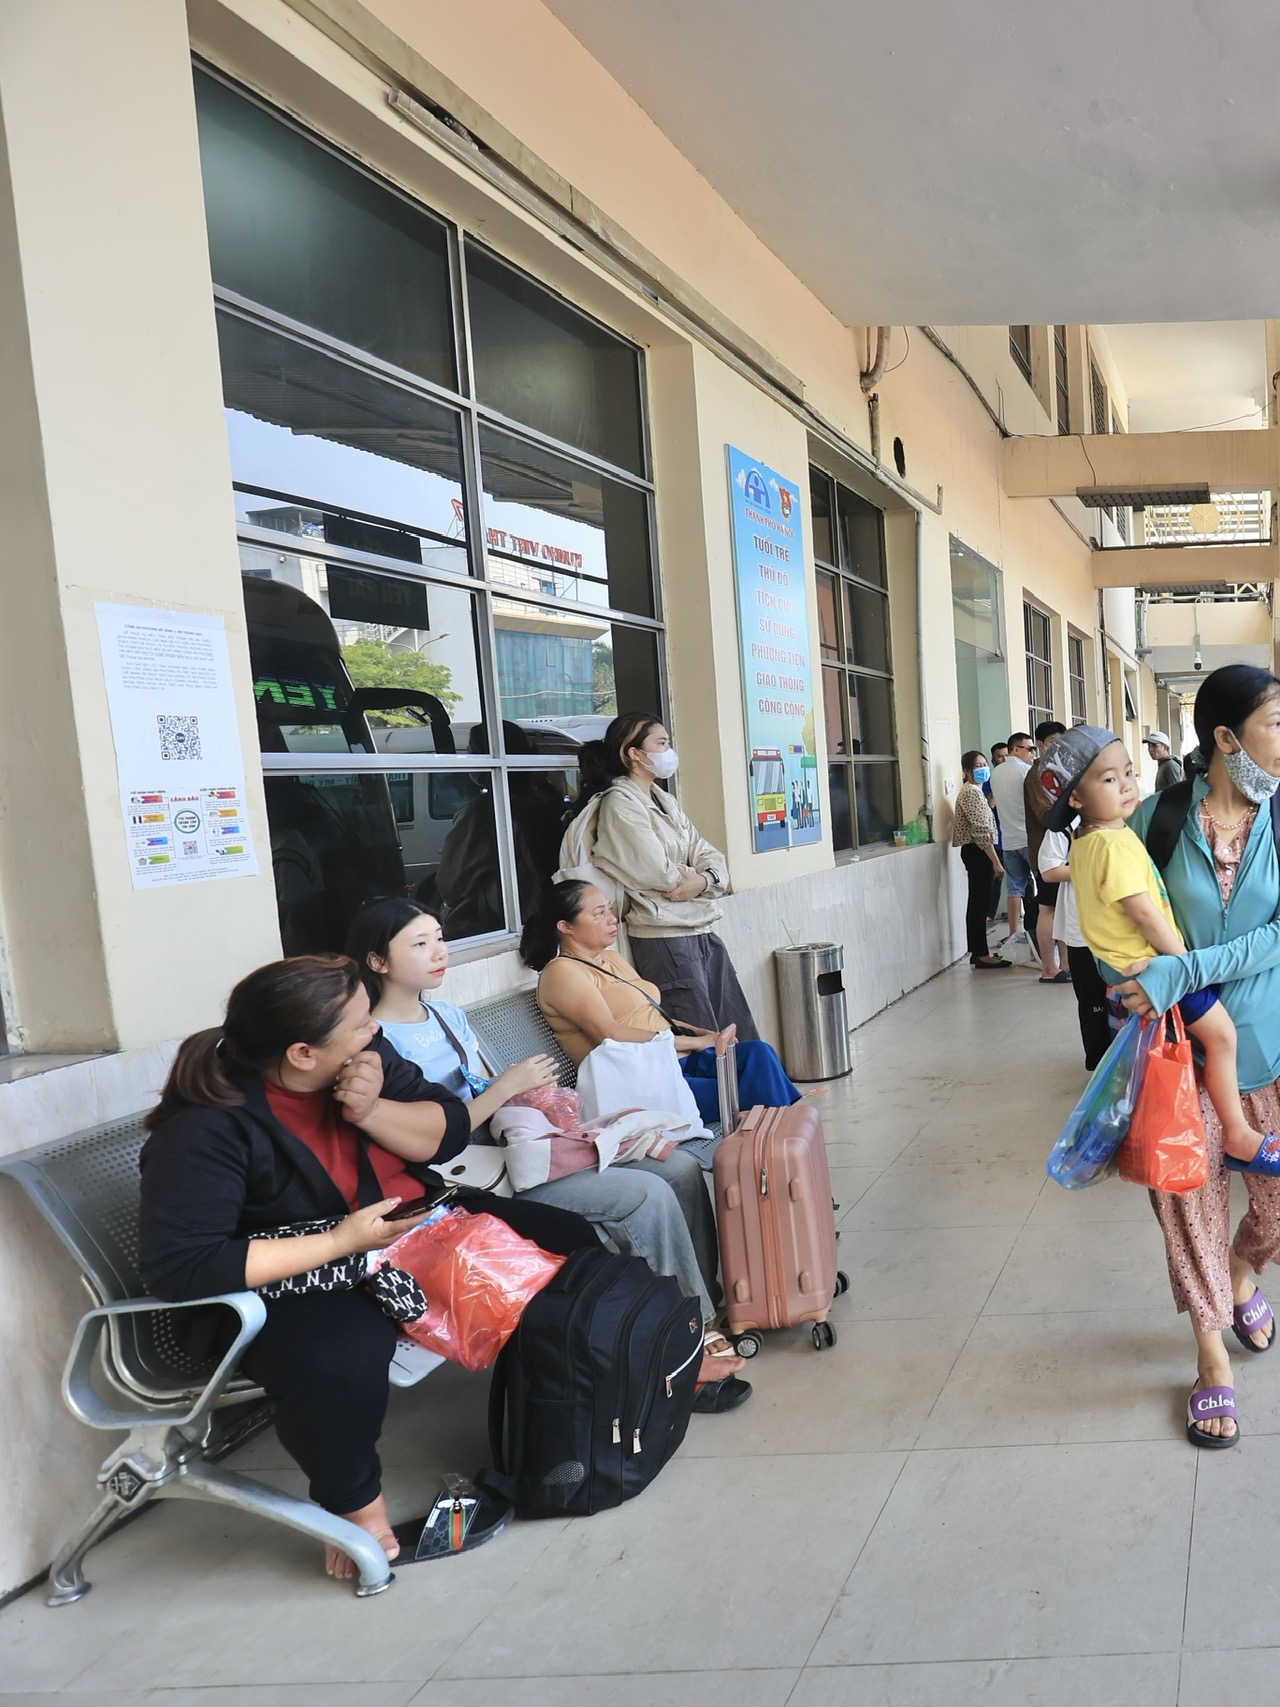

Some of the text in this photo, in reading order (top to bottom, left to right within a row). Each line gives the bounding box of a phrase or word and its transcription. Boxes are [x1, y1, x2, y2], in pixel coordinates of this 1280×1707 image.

[753, 535, 773, 556] TUỔI
[756, 672, 805, 691] GIAO THÔNG
[759, 698, 782, 713] CÔNG
